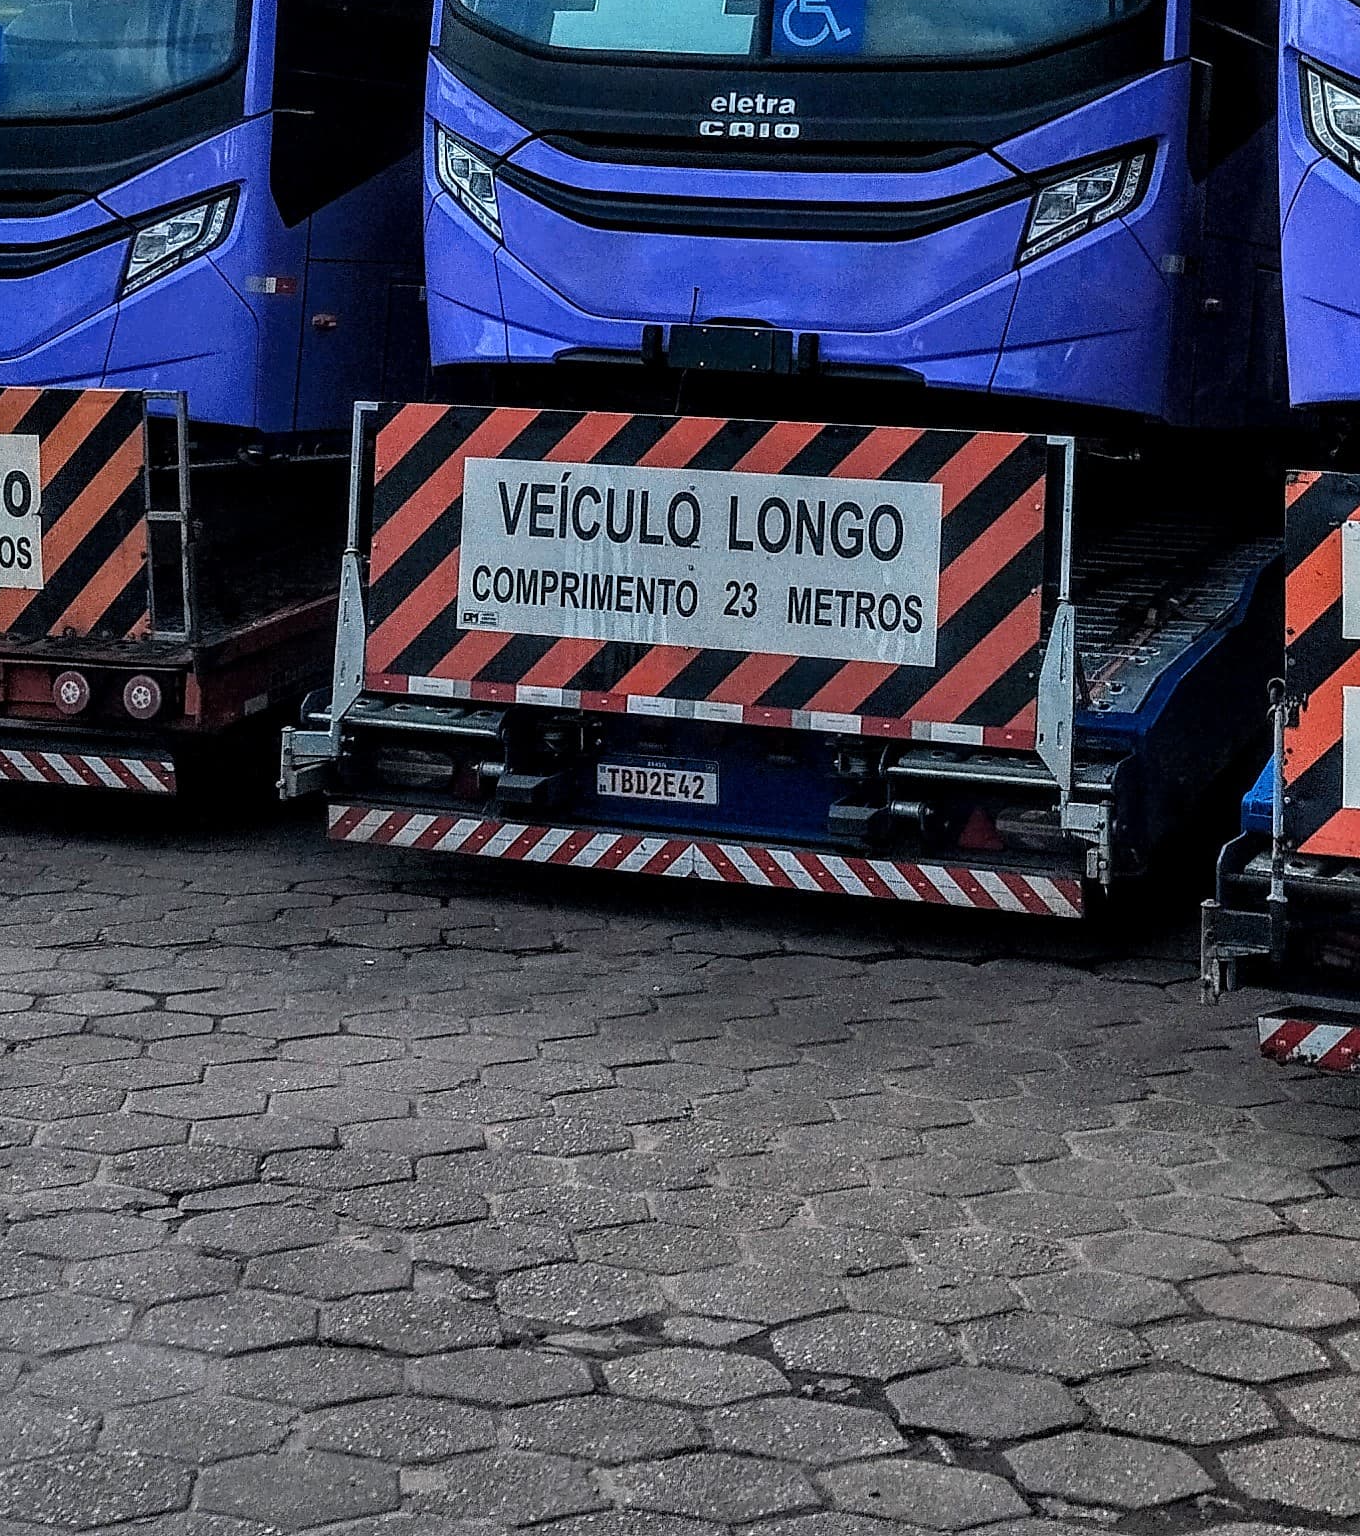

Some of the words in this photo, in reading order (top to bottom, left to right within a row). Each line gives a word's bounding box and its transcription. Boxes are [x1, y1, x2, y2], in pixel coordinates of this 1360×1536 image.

[710, 92, 796, 115] eletra
[699, 120, 800, 139] CAIO
[498, 471, 702, 548] VEÍCULO
[727, 495, 904, 562] LONGO
[471, 565, 699, 618] COMPRIMENTO
[722, 580, 758, 619] 23
[786, 586, 923, 634] METROS
[607, 767, 705, 800] TBD2E42
